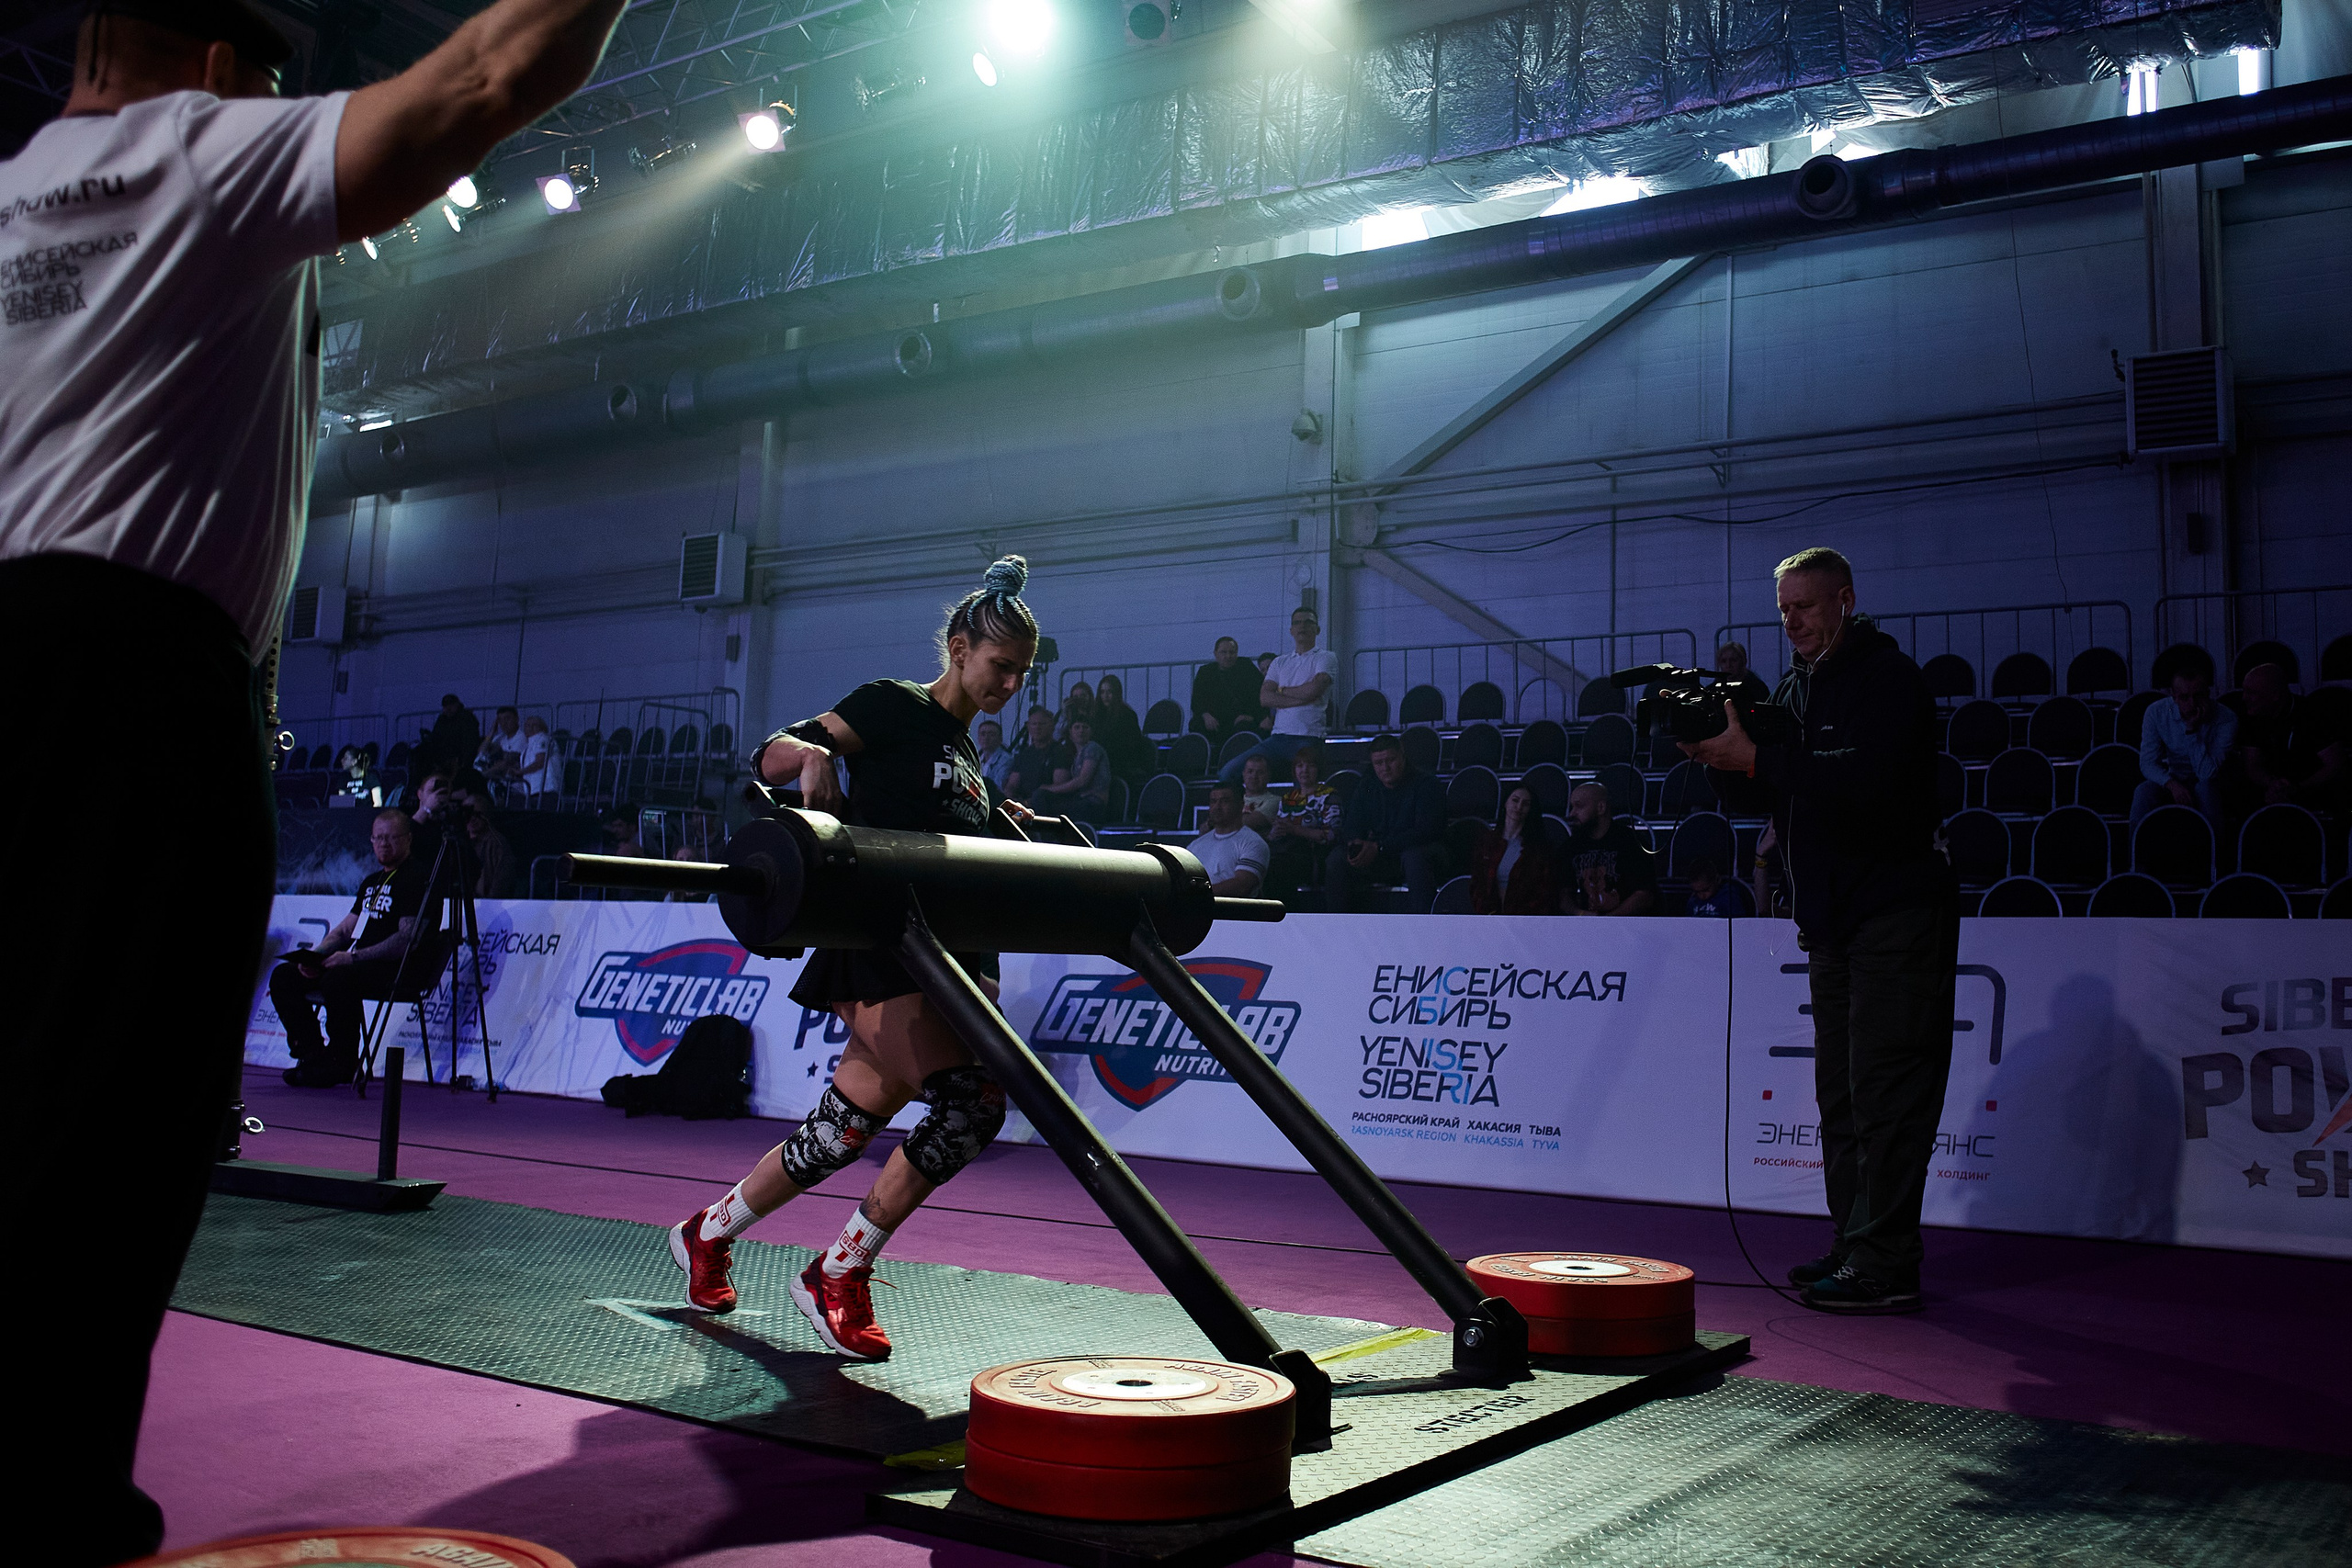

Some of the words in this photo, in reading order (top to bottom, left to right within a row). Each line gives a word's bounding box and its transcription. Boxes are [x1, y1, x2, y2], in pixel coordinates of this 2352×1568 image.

[1, 280, 83, 310] YENISEY
[6, 297, 87, 325] SIBERIA
[478, 929, 561, 955] ЕЙСКАЯ
[578, 955, 767, 1021] GENETICLAB
[1373, 963, 1627, 1001] ЕНИСЕЙСКАЯ
[1035, 979, 1295, 1055] GENETICAB
[1368, 994, 1511, 1030] СИБИРЬ
[1360, 1035, 1508, 1073] YENISEY
[1358, 1067, 1499, 1107] SIBERIA
[1416, 1130, 1457, 1143] REGION
[1464, 1134, 1524, 1148] KHAKASSIA
[1532, 1139, 1560, 1151] TYVA
[1430, 1115, 1460, 1129] КРАЙ
[1466, 1120, 1521, 1134] ХАКАСИЯ
[1529, 1125, 1561, 1137] ТЫВА
[1754, 1156, 1824, 1169] РОССИЙСКИЙ
[1937, 1168, 1991, 1181] ХОЛДИНГ
[842, 1235, 864, 1258] SBD
